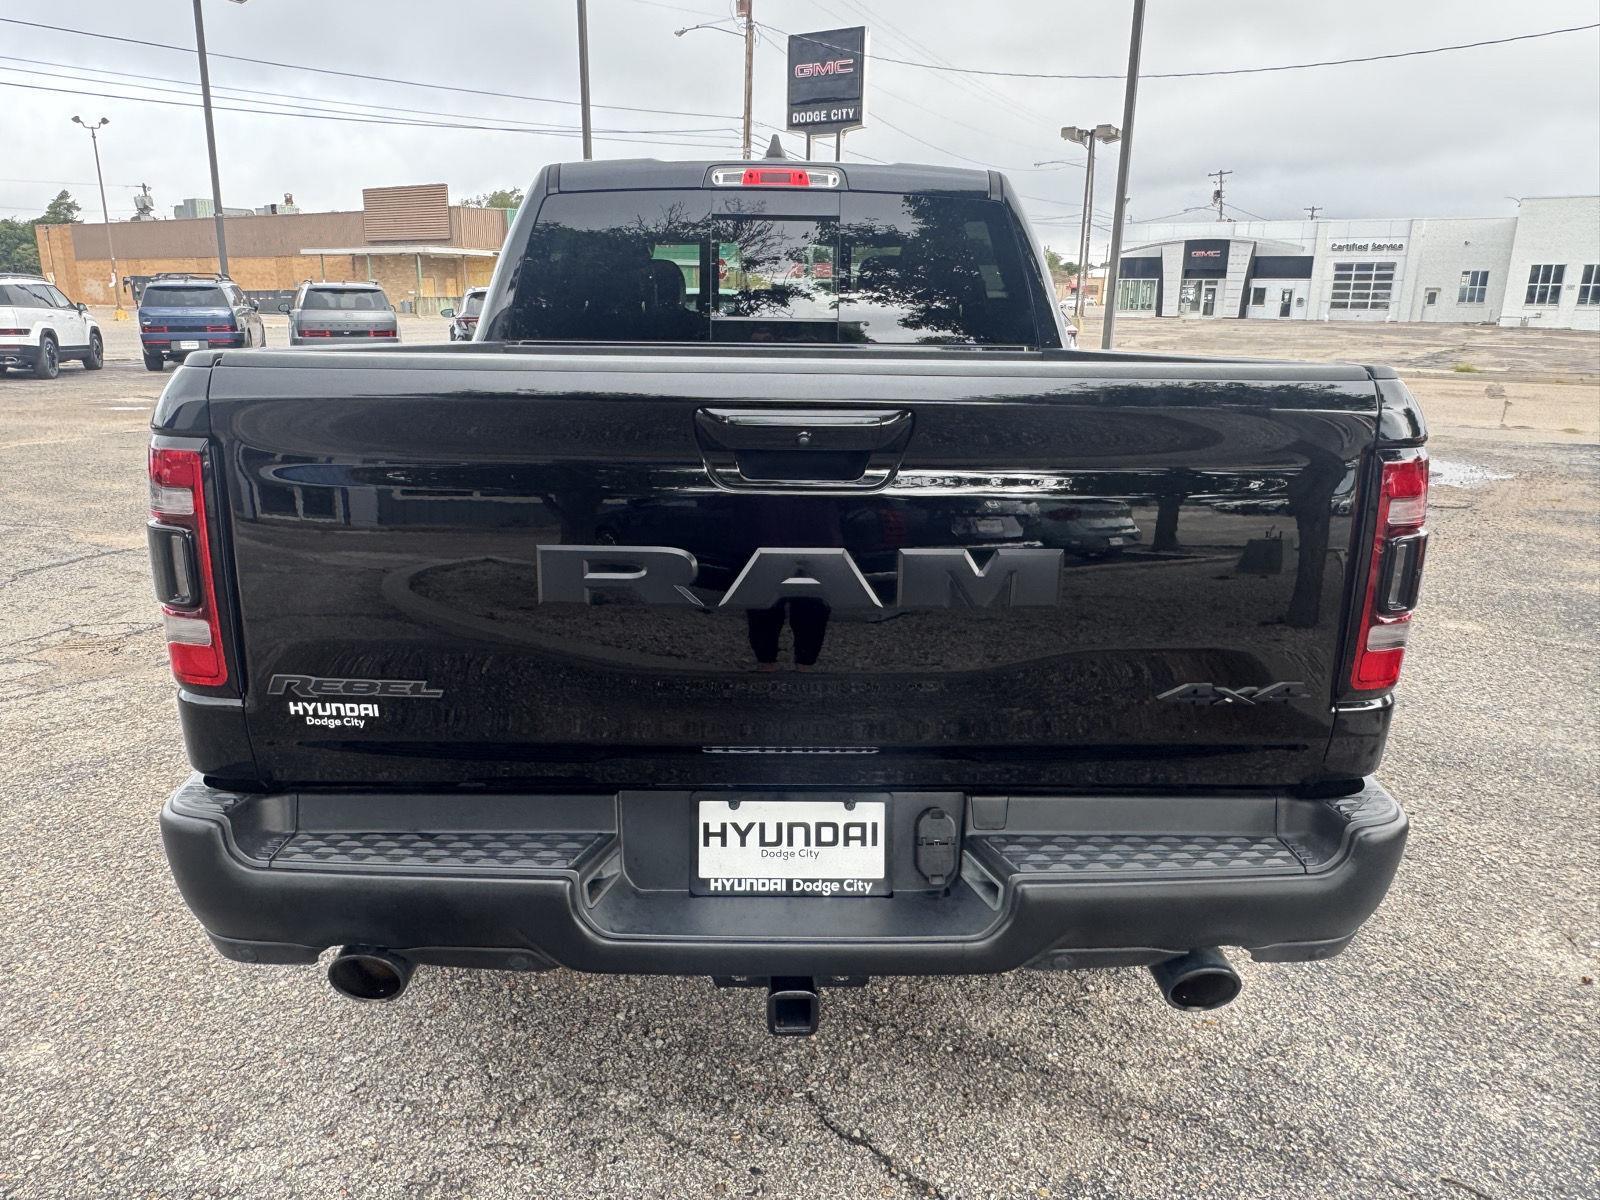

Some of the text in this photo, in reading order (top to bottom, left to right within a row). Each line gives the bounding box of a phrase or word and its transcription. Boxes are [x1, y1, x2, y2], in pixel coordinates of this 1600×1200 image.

[795, 59, 853, 78] GMC
[792, 107, 854, 123] DODGE CITY
[1331, 243, 1403, 251] Certified Service
[536, 544, 1064, 608] RAM
[267, 674, 444, 698] REBEL
[288, 701, 379, 717] HYUNDAI
[306, 716, 365, 728] Dodge City
[703, 822, 878, 847] HYUNDAI
[761, 849, 820, 860] Dodge City
[710, 878, 873, 896] HYUNDAI Dodge City
